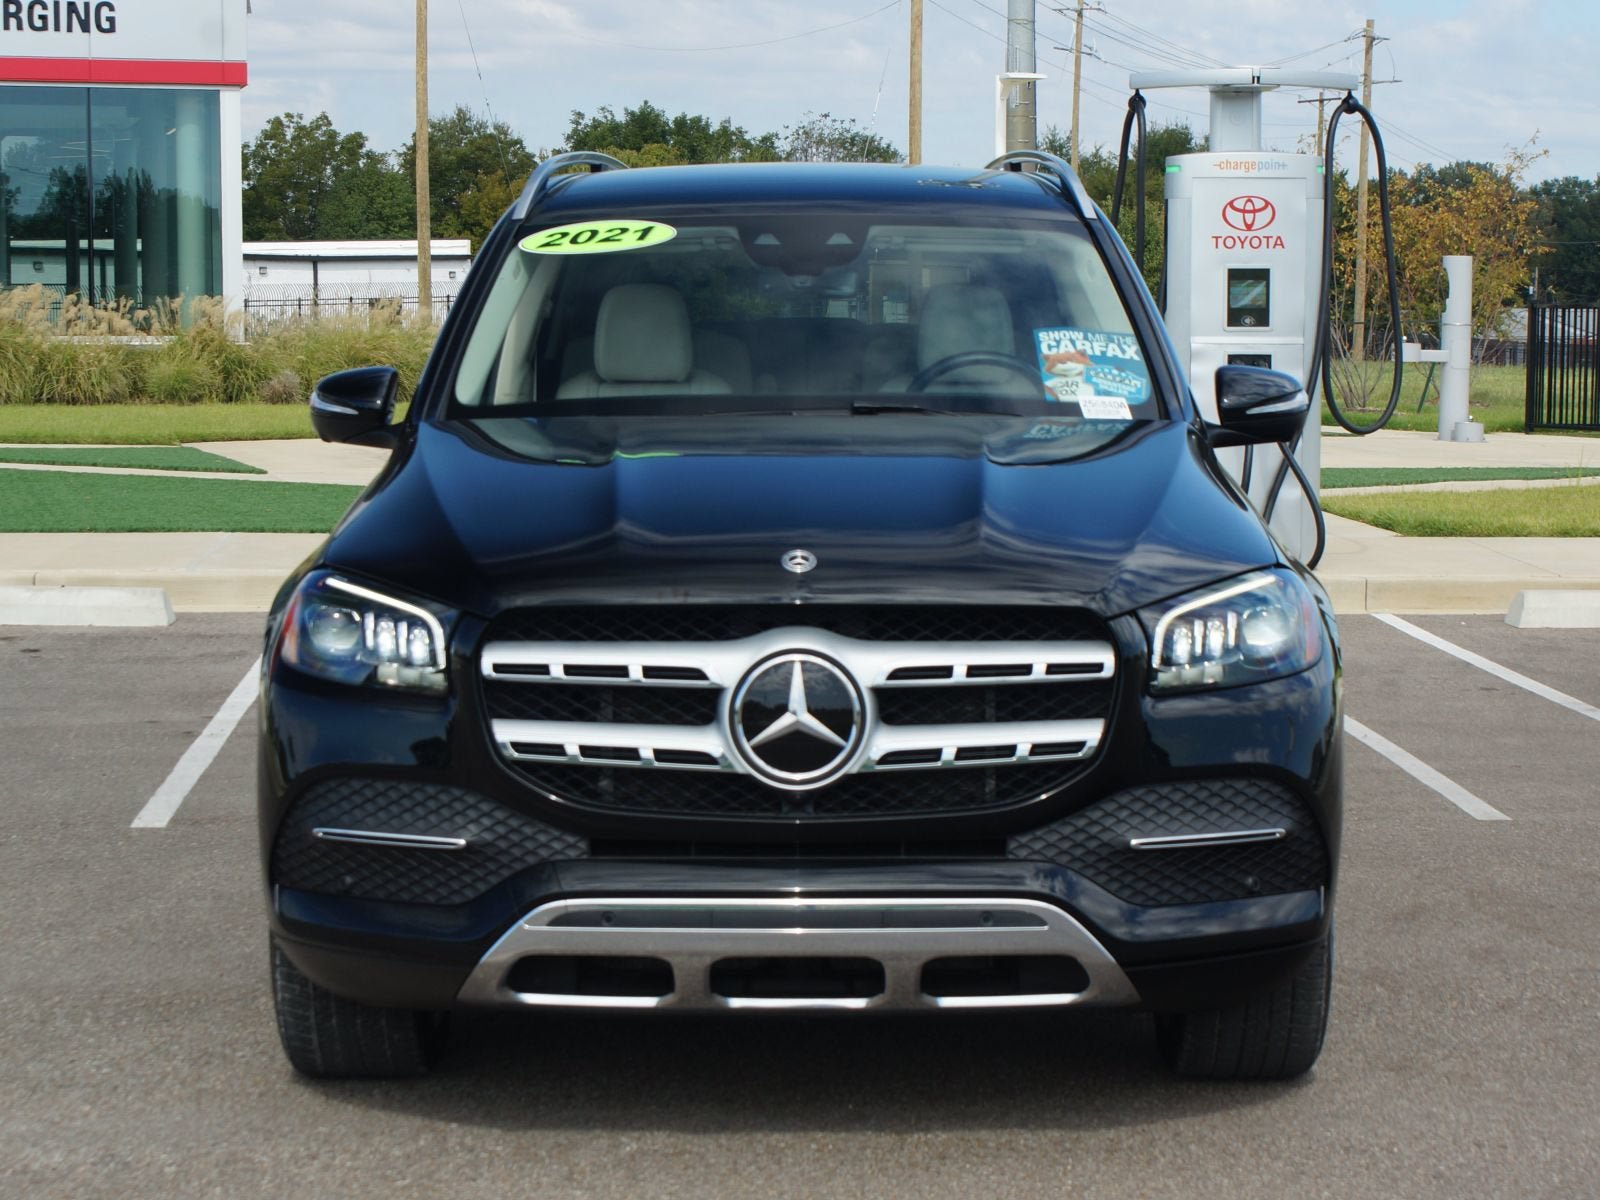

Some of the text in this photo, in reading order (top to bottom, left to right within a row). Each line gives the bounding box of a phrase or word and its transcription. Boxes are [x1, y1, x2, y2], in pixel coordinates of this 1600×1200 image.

[3, 0, 116, 33] RGING
[1213, 159, 1287, 173] chargepoint
[537, 225, 656, 249] 2021
[1211, 235, 1285, 249] TOYOTA
[1038, 330, 1084, 341] SHOW
[1040, 339, 1141, 360] CARFAX
